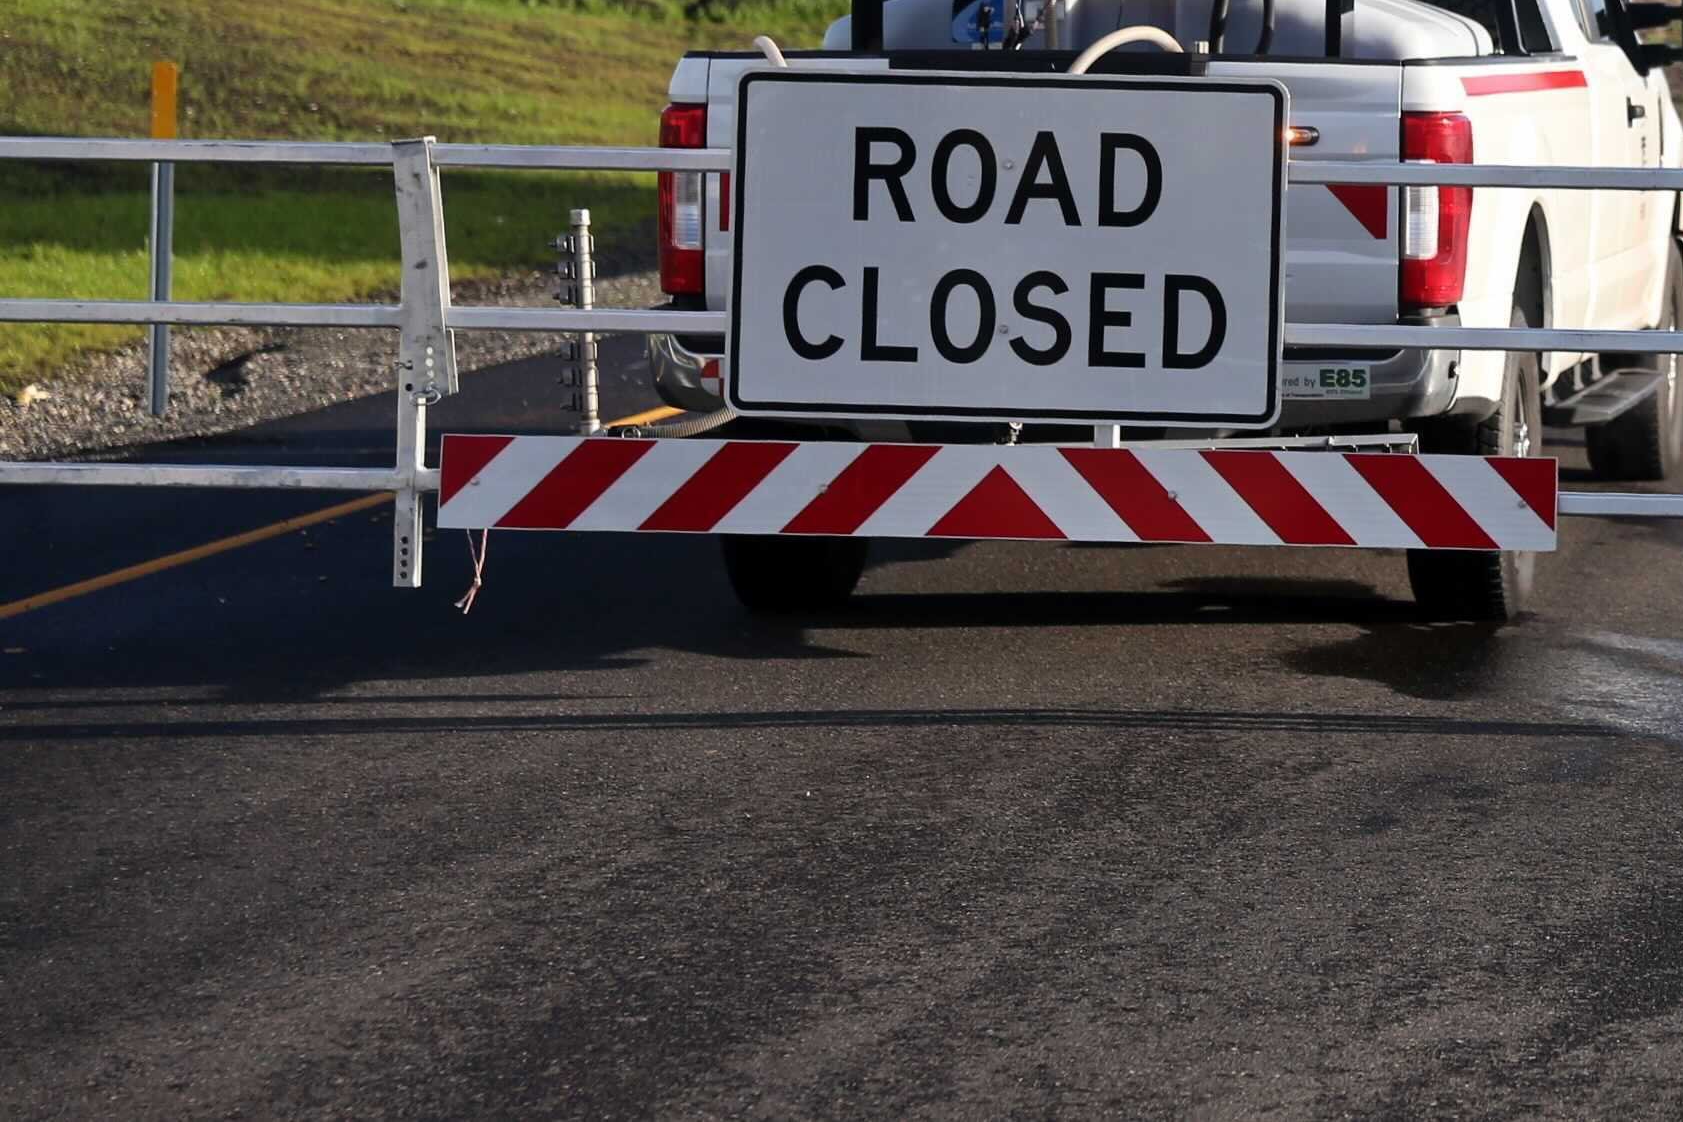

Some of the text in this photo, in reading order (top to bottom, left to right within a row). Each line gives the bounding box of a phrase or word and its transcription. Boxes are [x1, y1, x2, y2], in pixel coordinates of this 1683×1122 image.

[852, 126, 1163, 228] ROAD
[782, 264, 1228, 370] CLOSED
[1303, 377, 1316, 389] by
[1319, 368, 1367, 388] E85
